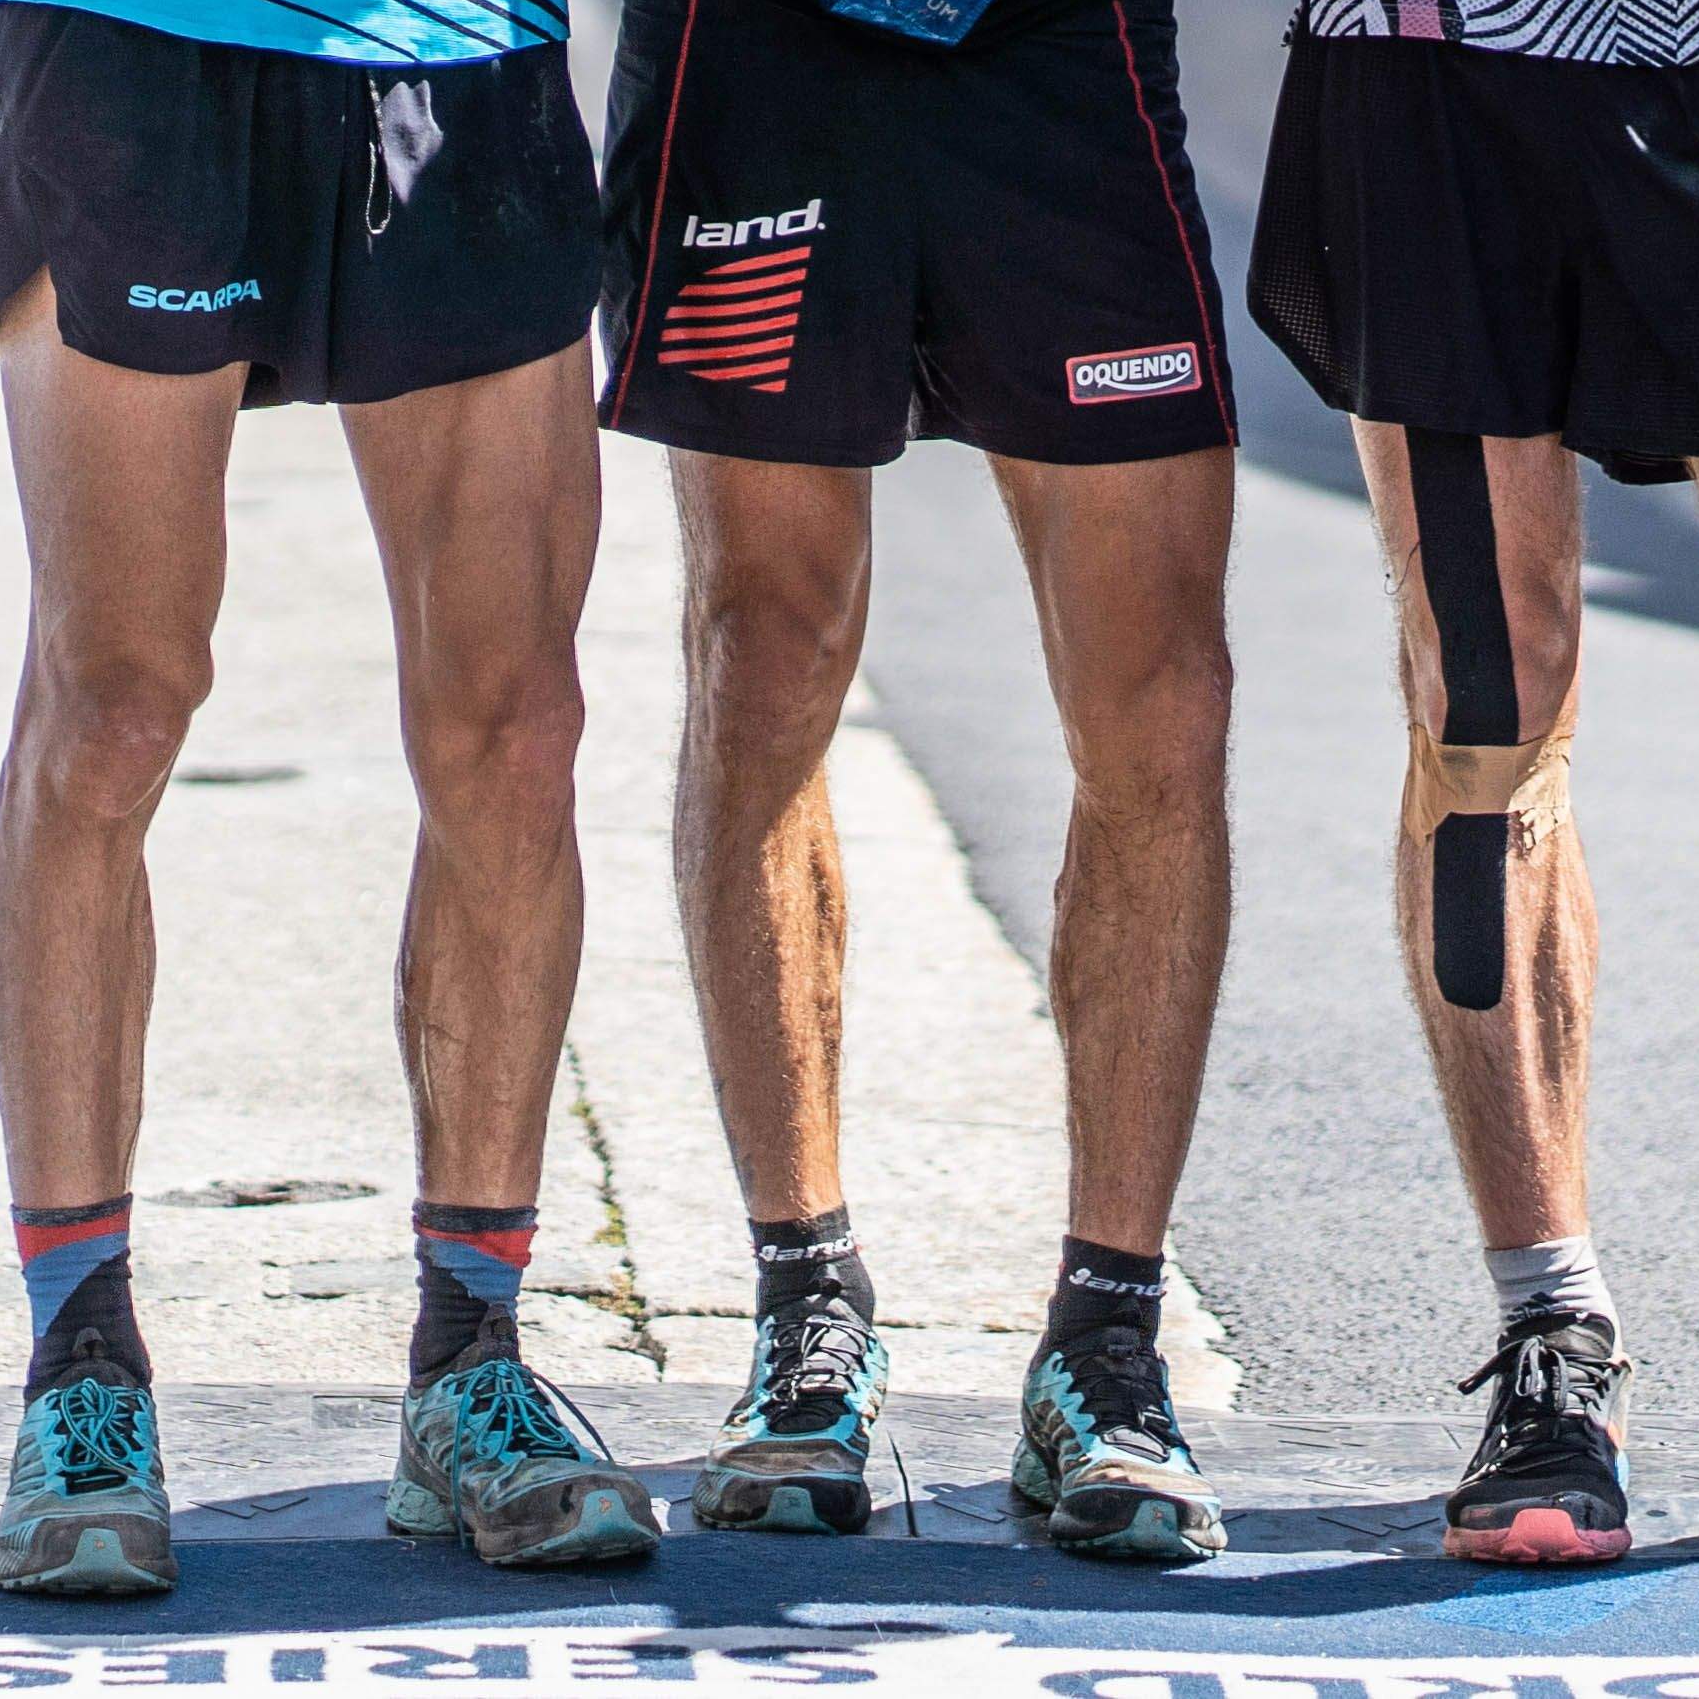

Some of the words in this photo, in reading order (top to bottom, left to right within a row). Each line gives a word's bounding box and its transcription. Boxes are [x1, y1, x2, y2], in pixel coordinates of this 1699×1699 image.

[682, 198, 826, 247] land.
[127, 278, 262, 313] SCARPA
[1075, 351, 1191, 389] OQUENDO
